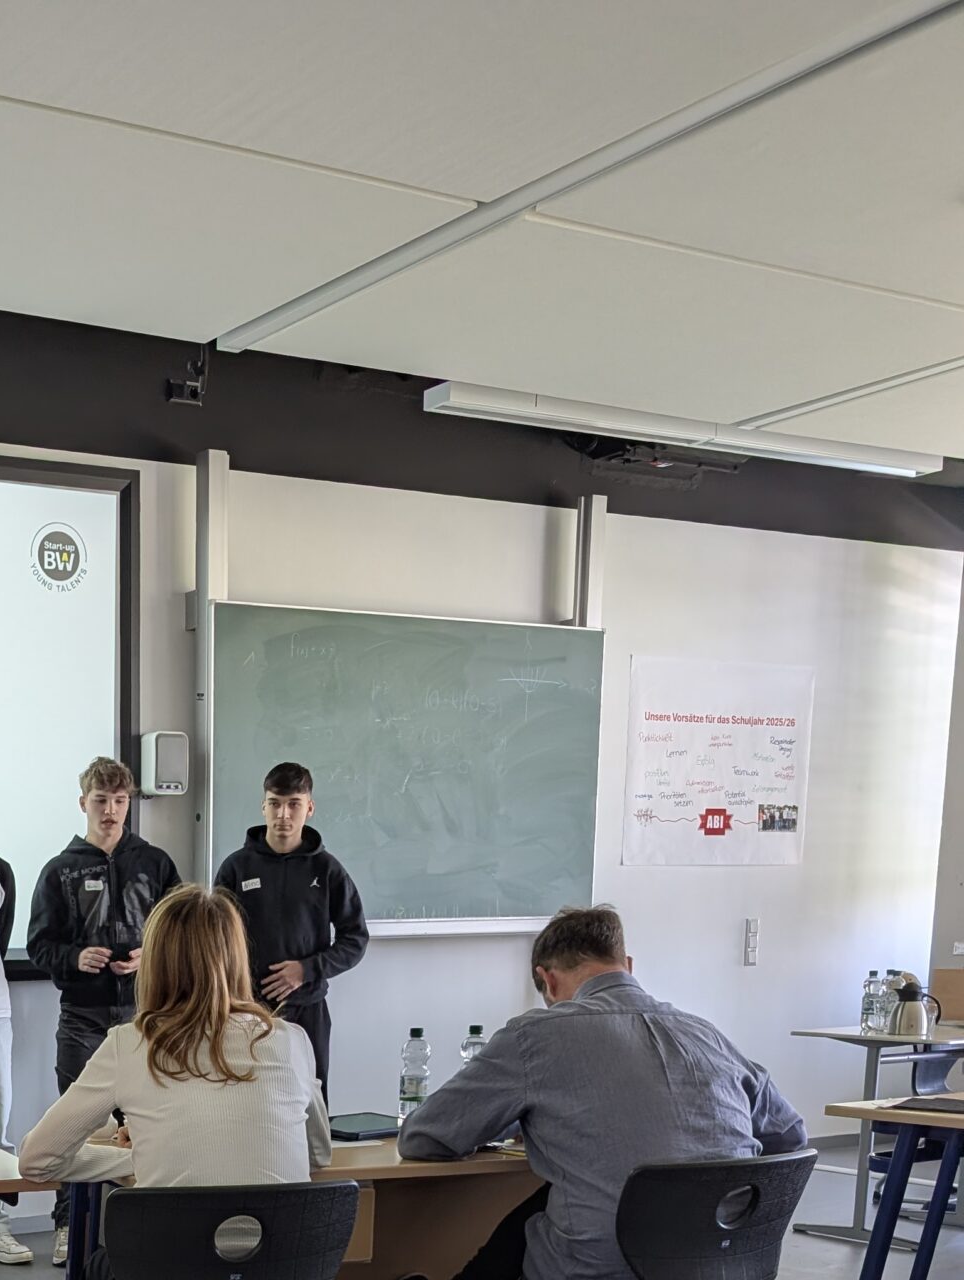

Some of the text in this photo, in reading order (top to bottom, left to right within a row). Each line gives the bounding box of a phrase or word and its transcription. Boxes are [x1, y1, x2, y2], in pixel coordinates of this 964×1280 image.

[44, 541, 75, 552] Start-up
[30, 562, 88, 593] YOUNG TALENTS
[644, 711, 796, 728] Unsere Vorsätze für das Schuljahr 2025/26
[706, 815, 724, 829] ABI
